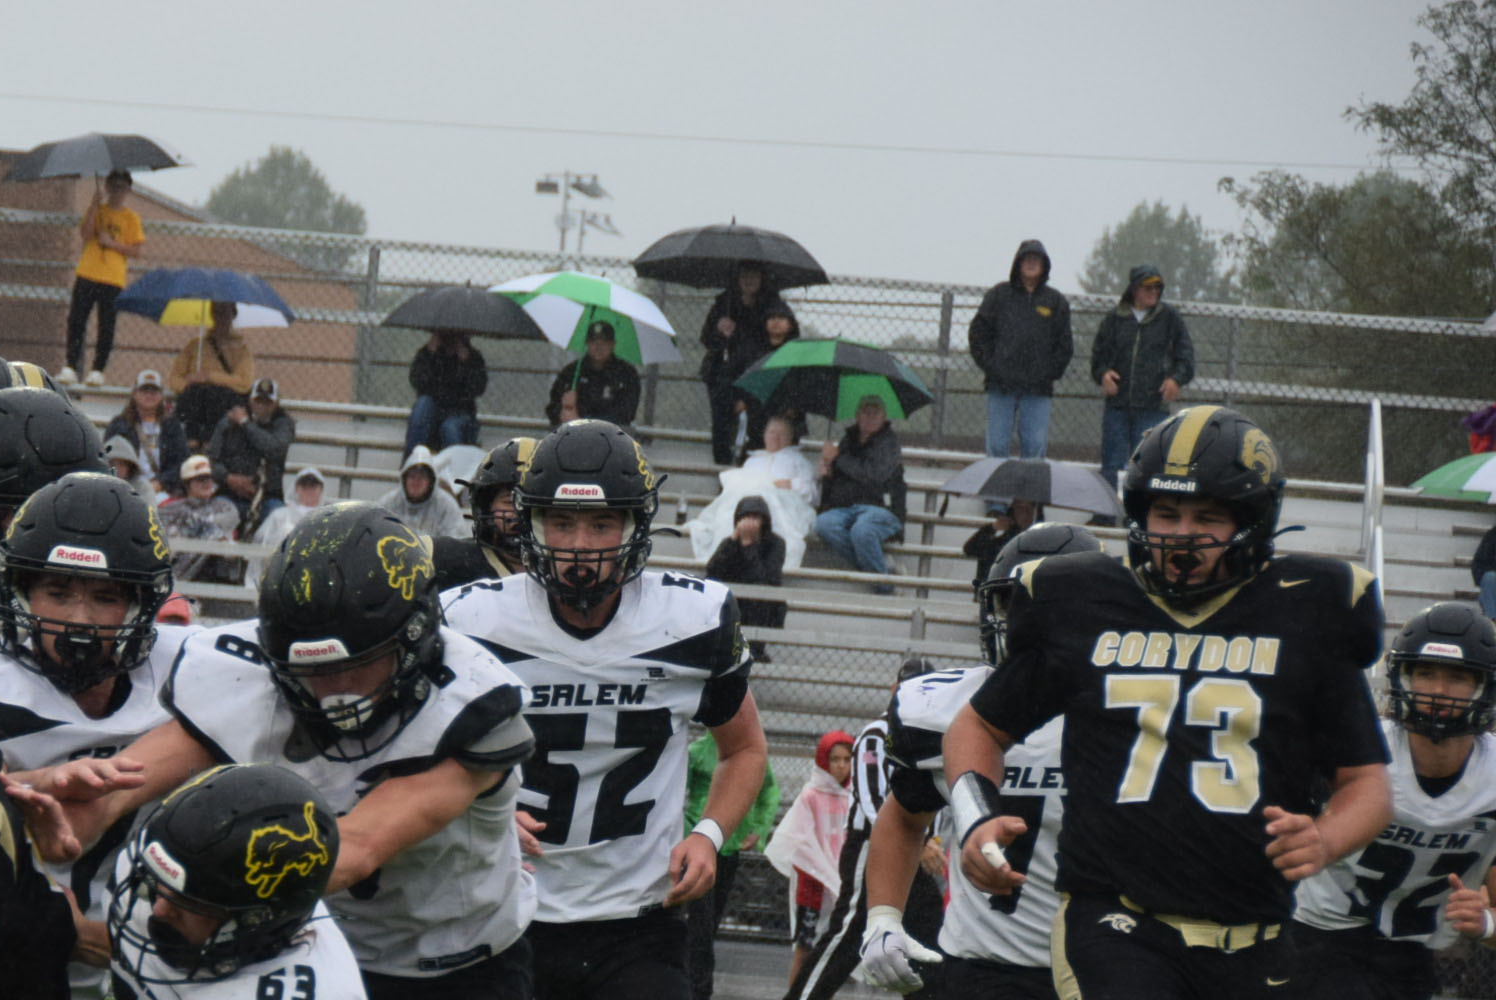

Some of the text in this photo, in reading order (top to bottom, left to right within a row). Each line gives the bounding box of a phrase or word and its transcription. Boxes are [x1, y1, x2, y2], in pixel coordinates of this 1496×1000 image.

[561, 486, 599, 496] Riddell
[1151, 478, 1196, 491] Riddell
[56, 548, 100, 563] Riddell
[1091, 631, 1281, 675] CORYDON
[528, 683, 649, 708] SALEM
[1105, 674, 1263, 814] 73
[515, 706, 674, 846] 52
[1377, 824, 1472, 850] SALEM
